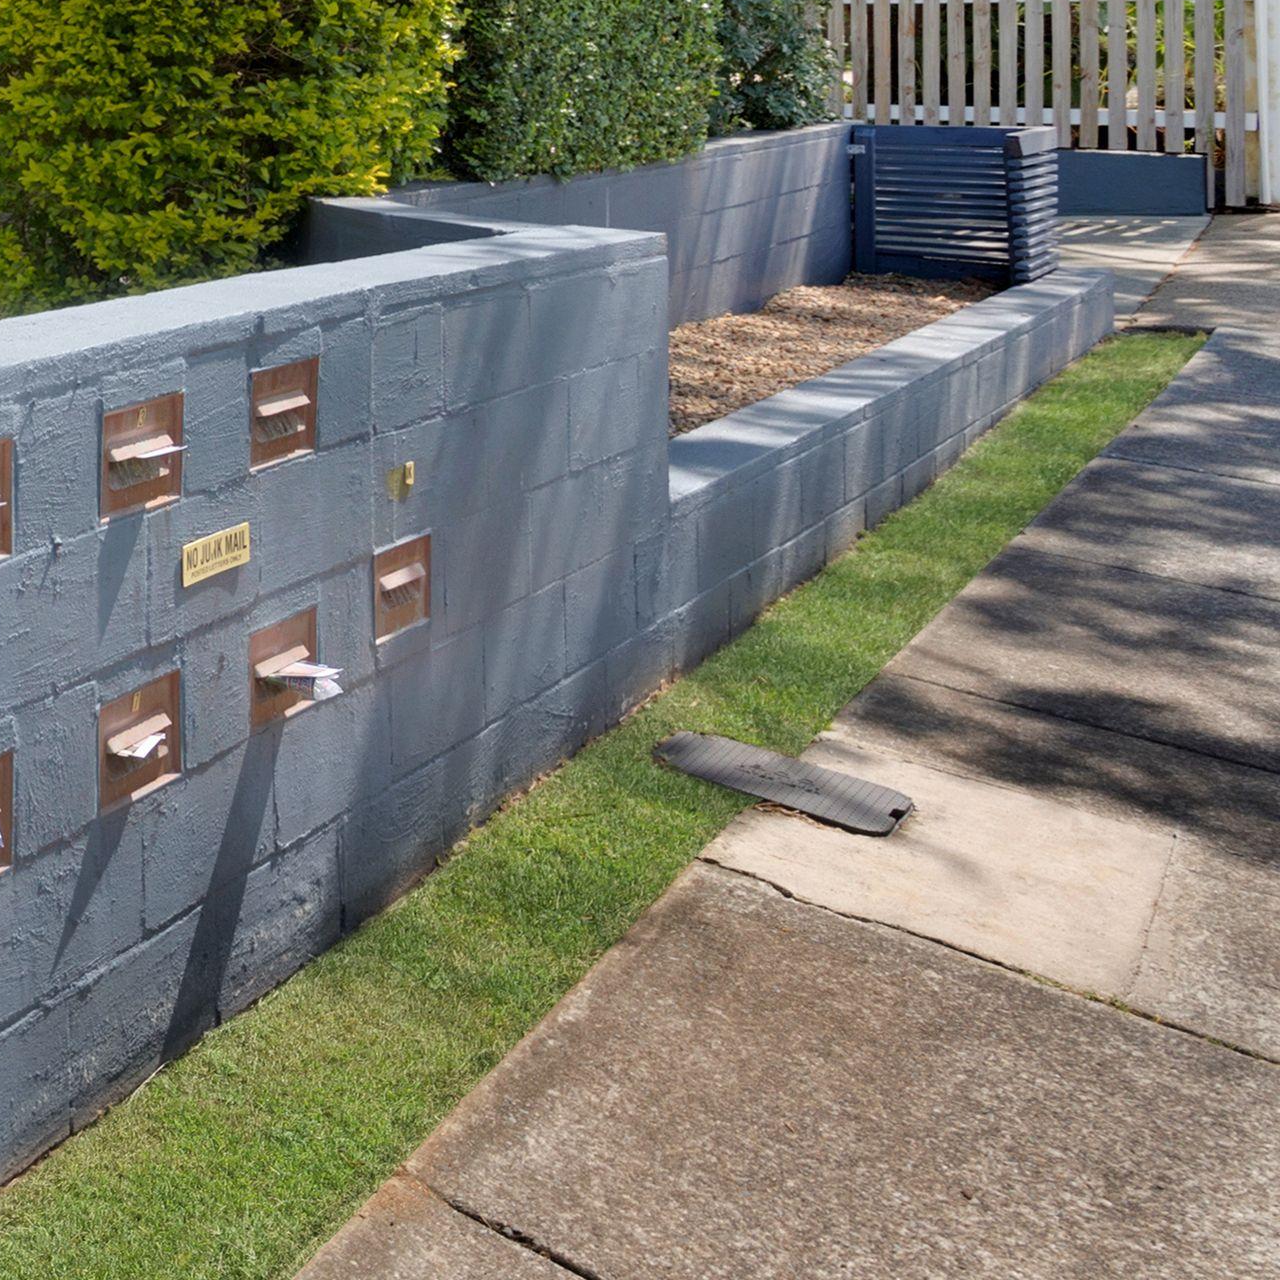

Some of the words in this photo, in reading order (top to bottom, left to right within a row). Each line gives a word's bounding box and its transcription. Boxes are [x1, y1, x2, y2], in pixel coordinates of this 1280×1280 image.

[186, 547, 198, 570] NO
[200, 538, 223, 563] JUNK
[225, 530, 247, 555] MAIL
